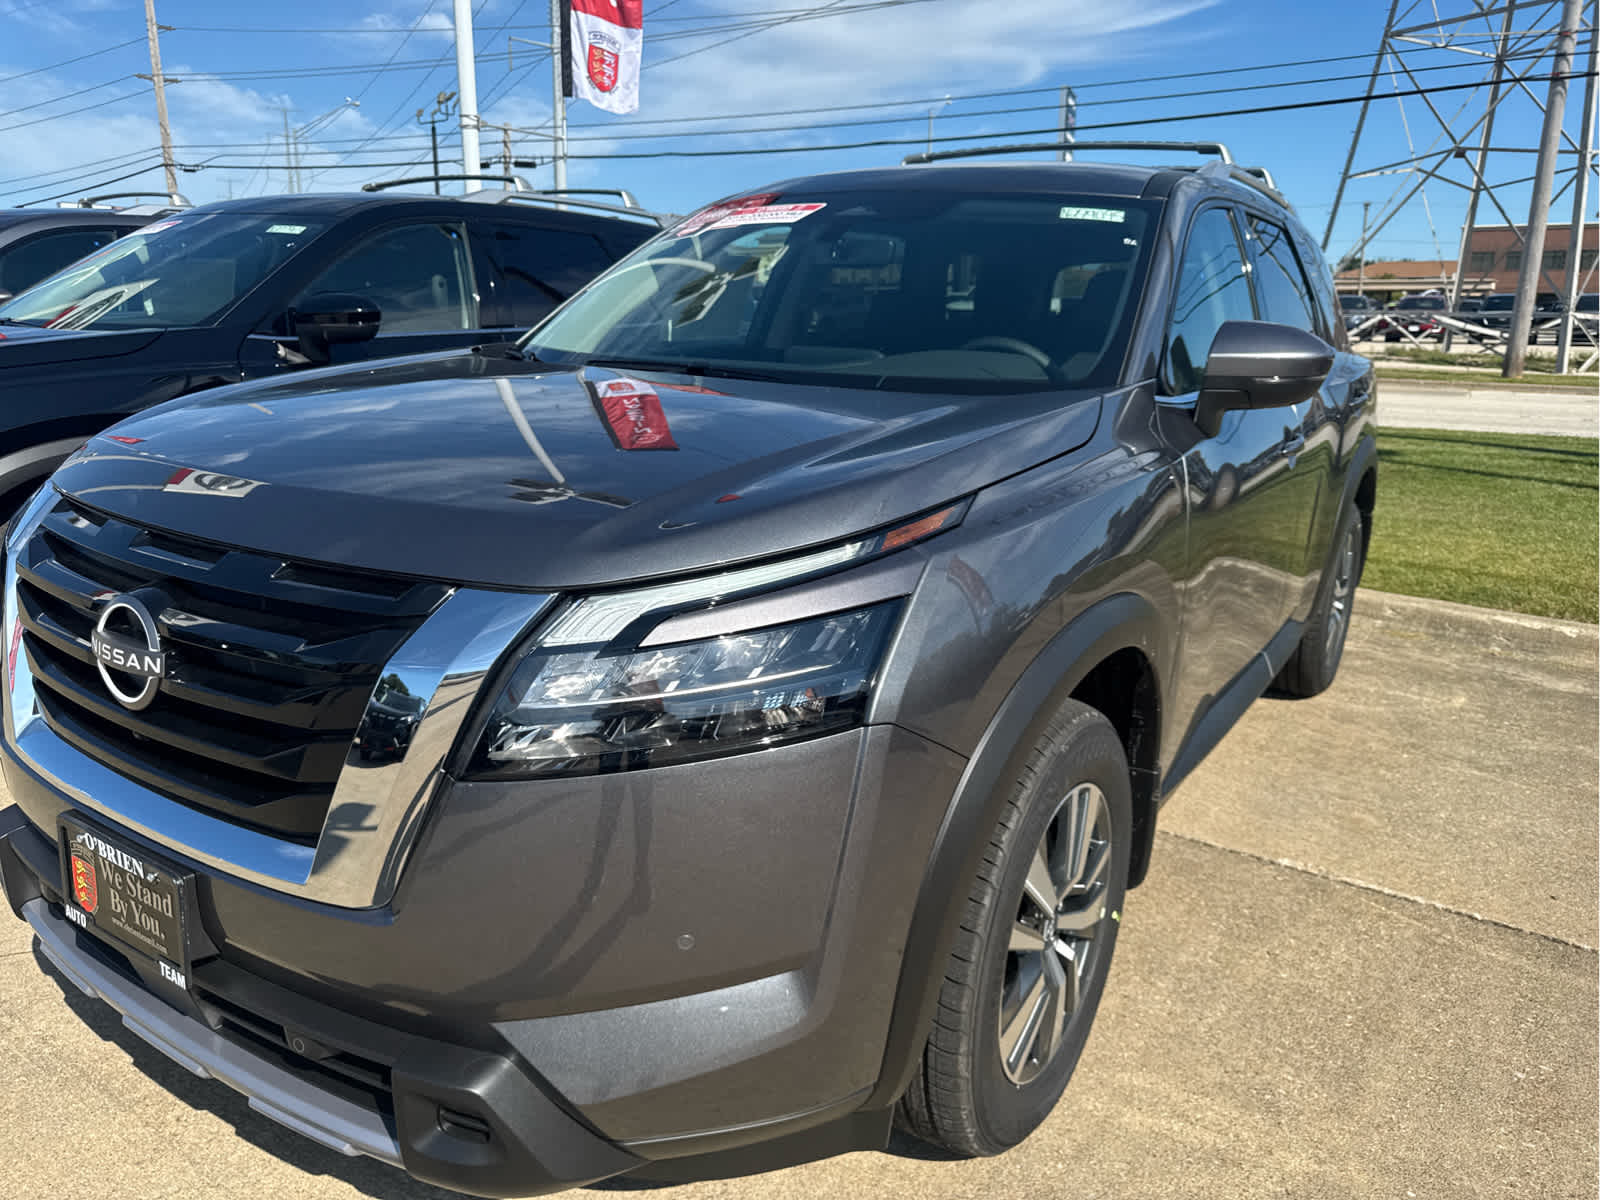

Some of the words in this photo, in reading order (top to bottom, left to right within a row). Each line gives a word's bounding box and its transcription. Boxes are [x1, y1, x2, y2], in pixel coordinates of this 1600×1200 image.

[92, 635, 160, 673] NISSAN
[85, 833, 144, 880] O'BRIEN
[99, 857, 122, 889] We
[126, 873, 173, 918] Stand
[111, 888, 127, 922] By
[66, 906, 86, 928] AUTO
[159, 961, 186, 990] TEAM
